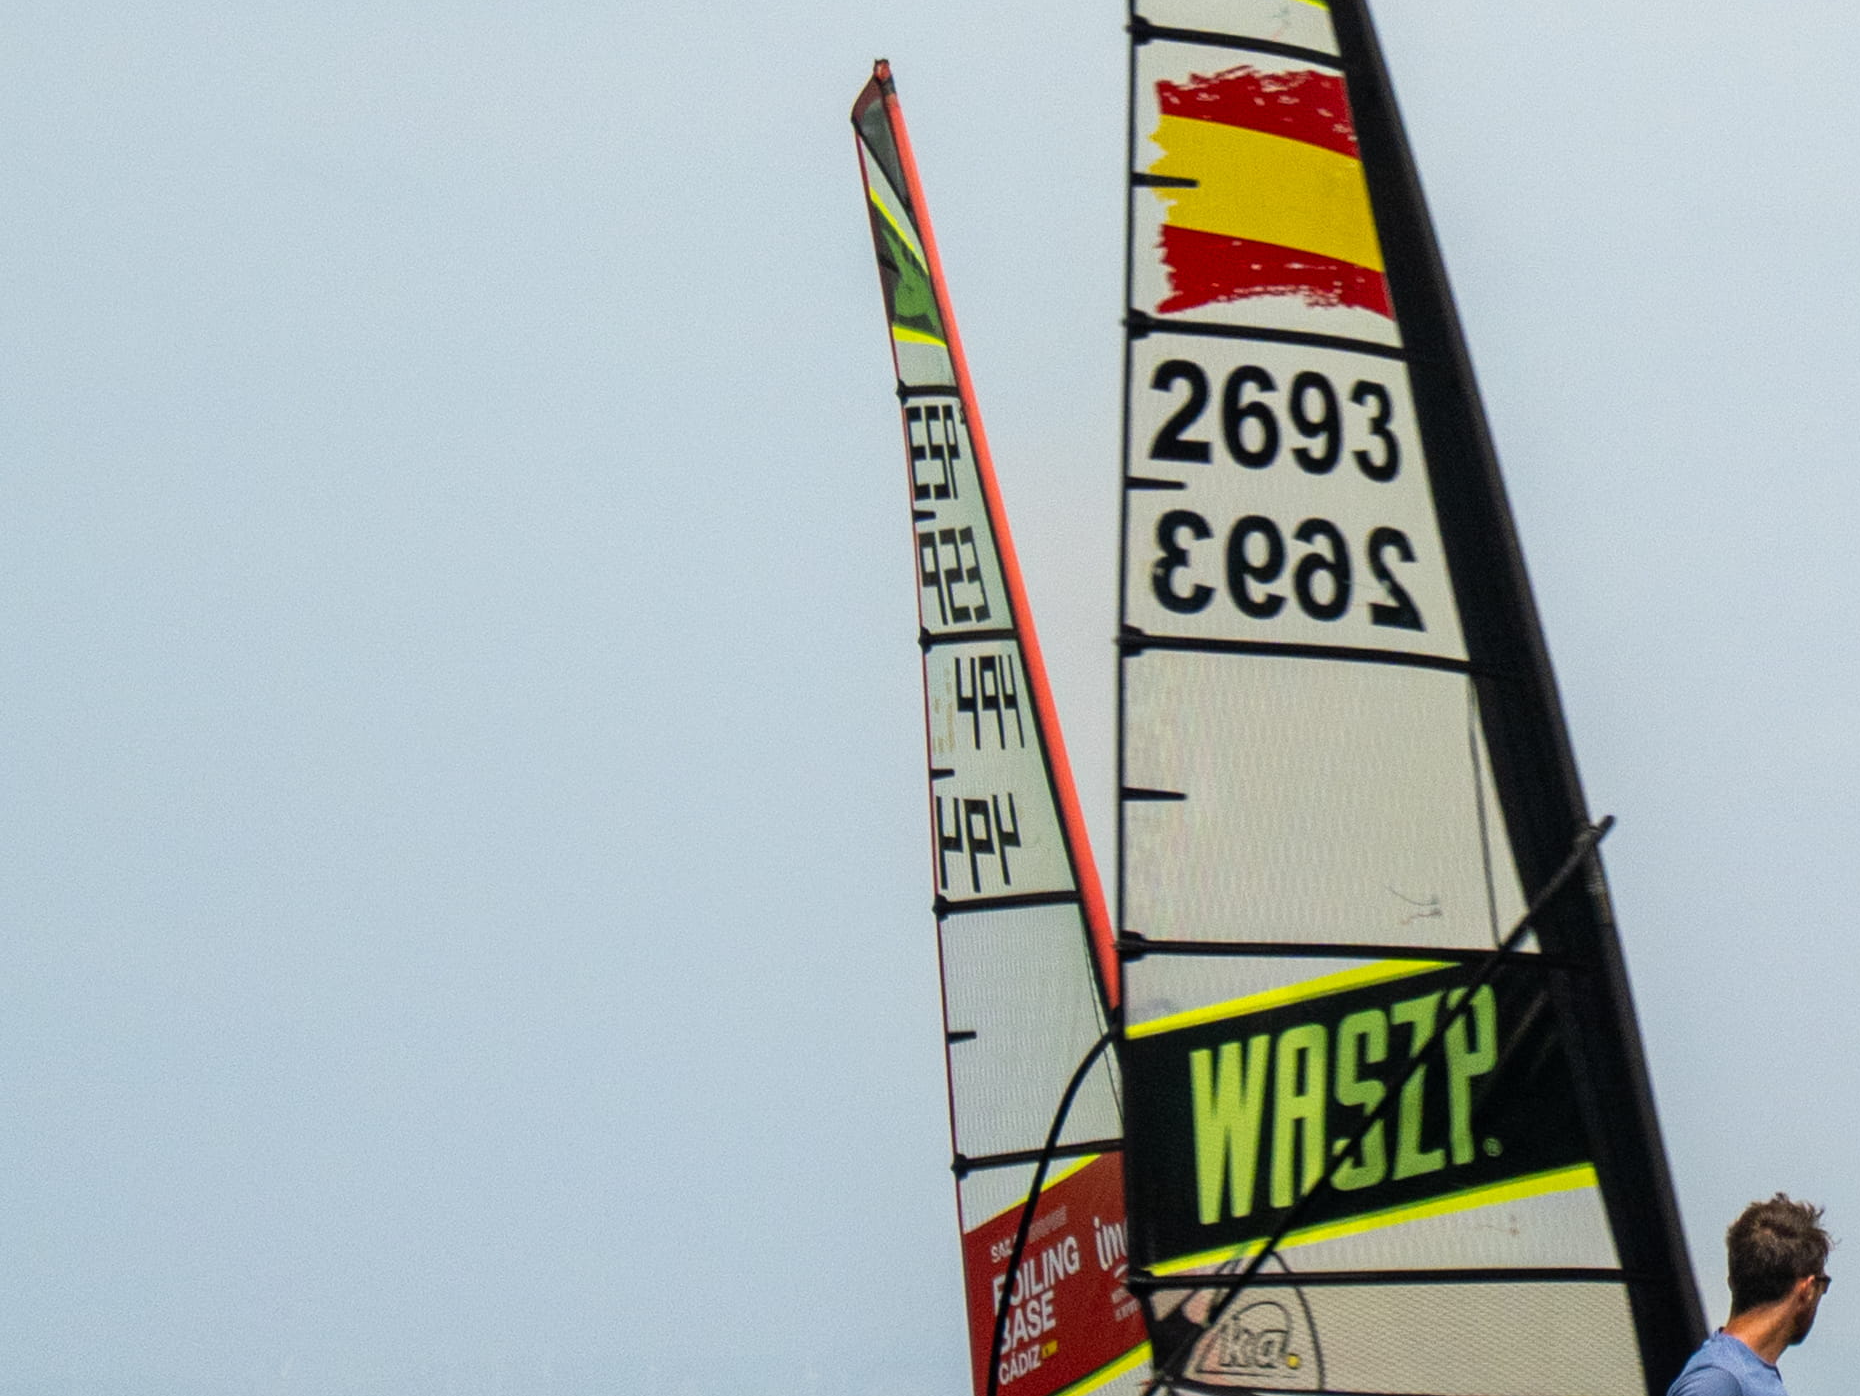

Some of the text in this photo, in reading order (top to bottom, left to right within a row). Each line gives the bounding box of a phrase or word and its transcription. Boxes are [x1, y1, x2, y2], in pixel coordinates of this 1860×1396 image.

[1149, 359, 1401, 484] 2693
[954, 654, 1025, 751] 494
[1189, 984, 1499, 1225] WASZP
